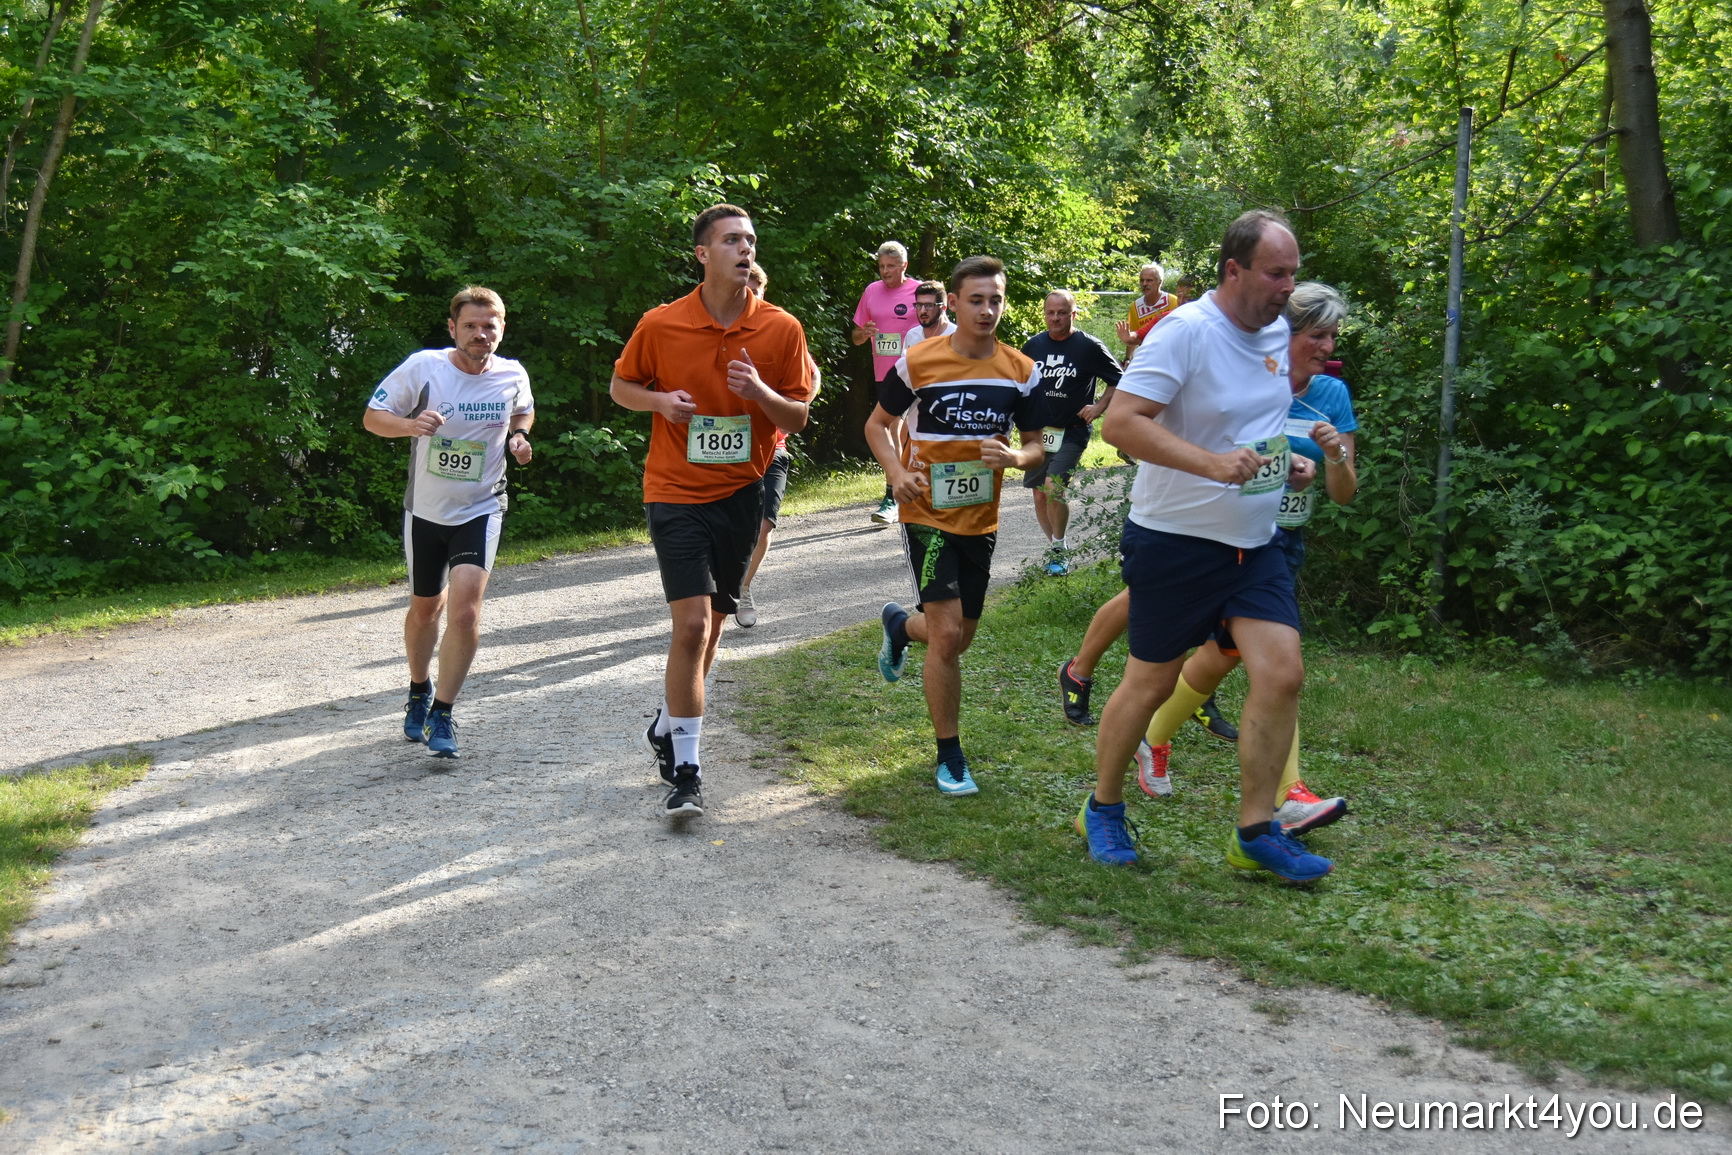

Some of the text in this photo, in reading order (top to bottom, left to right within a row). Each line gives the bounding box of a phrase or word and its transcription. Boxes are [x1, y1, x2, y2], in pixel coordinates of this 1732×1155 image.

[878, 341, 898, 350] 1770
[1044, 389, 1068, 398] elliebe.
[458, 402, 506, 412] HAUBNER
[464, 413, 501, 421] TREPPEN
[697, 433, 744, 450] 1803
[439, 452, 472, 470] 999
[945, 477, 979, 495] 750
